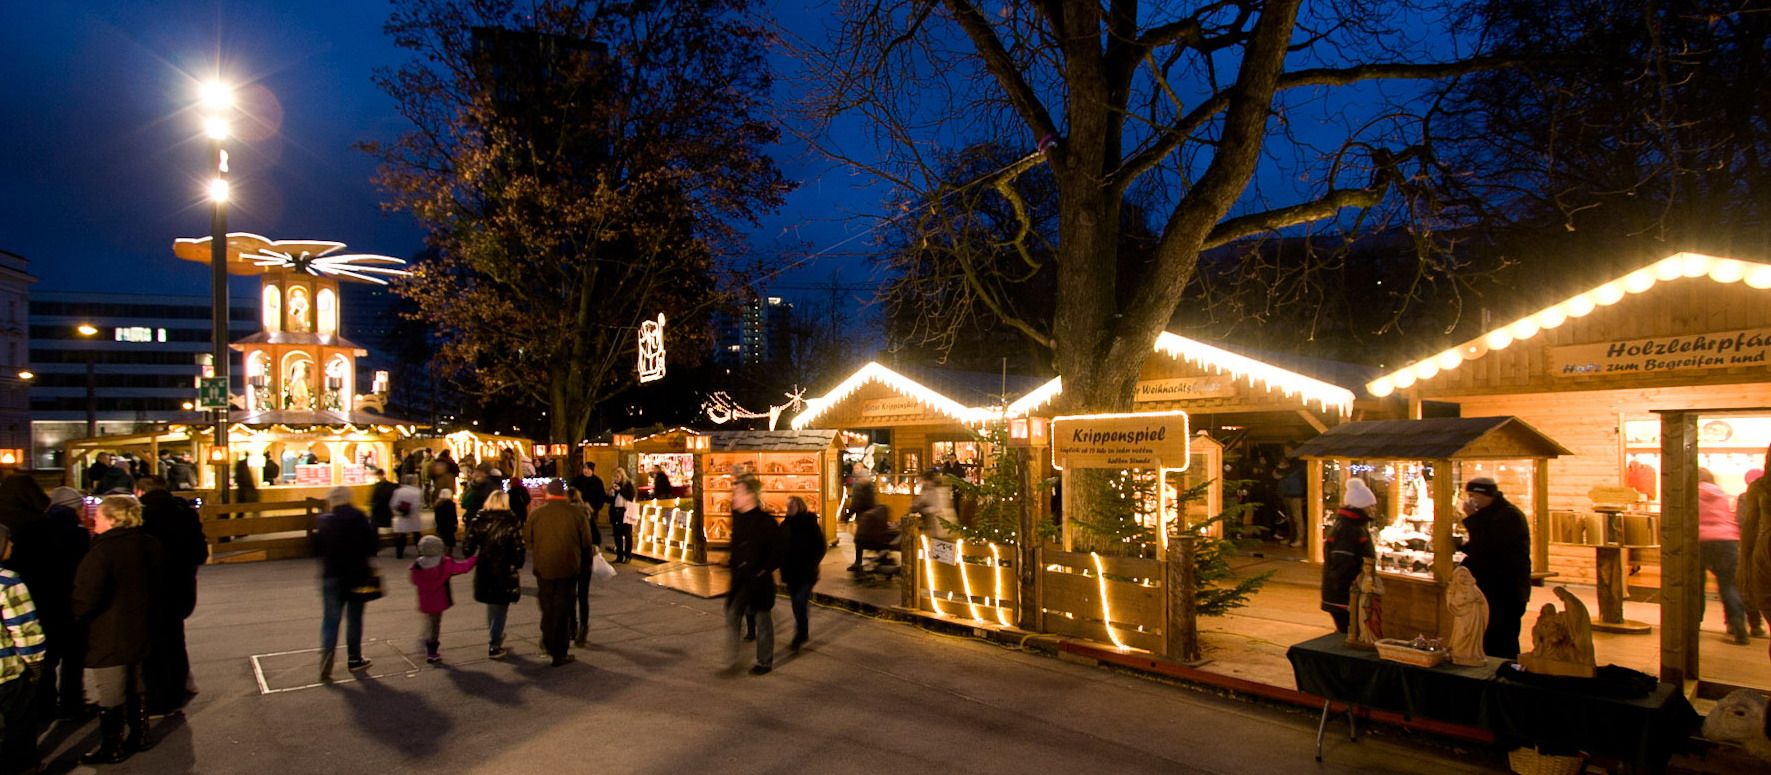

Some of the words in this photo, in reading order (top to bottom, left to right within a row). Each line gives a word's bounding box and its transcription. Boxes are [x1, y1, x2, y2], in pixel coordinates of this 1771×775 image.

[1606, 363, 1639, 372] zum
[1644, 356, 1724, 370] Begreifen
[1730, 350, 1765, 363] und
[1073, 426, 1165, 445] Krippenspiel
